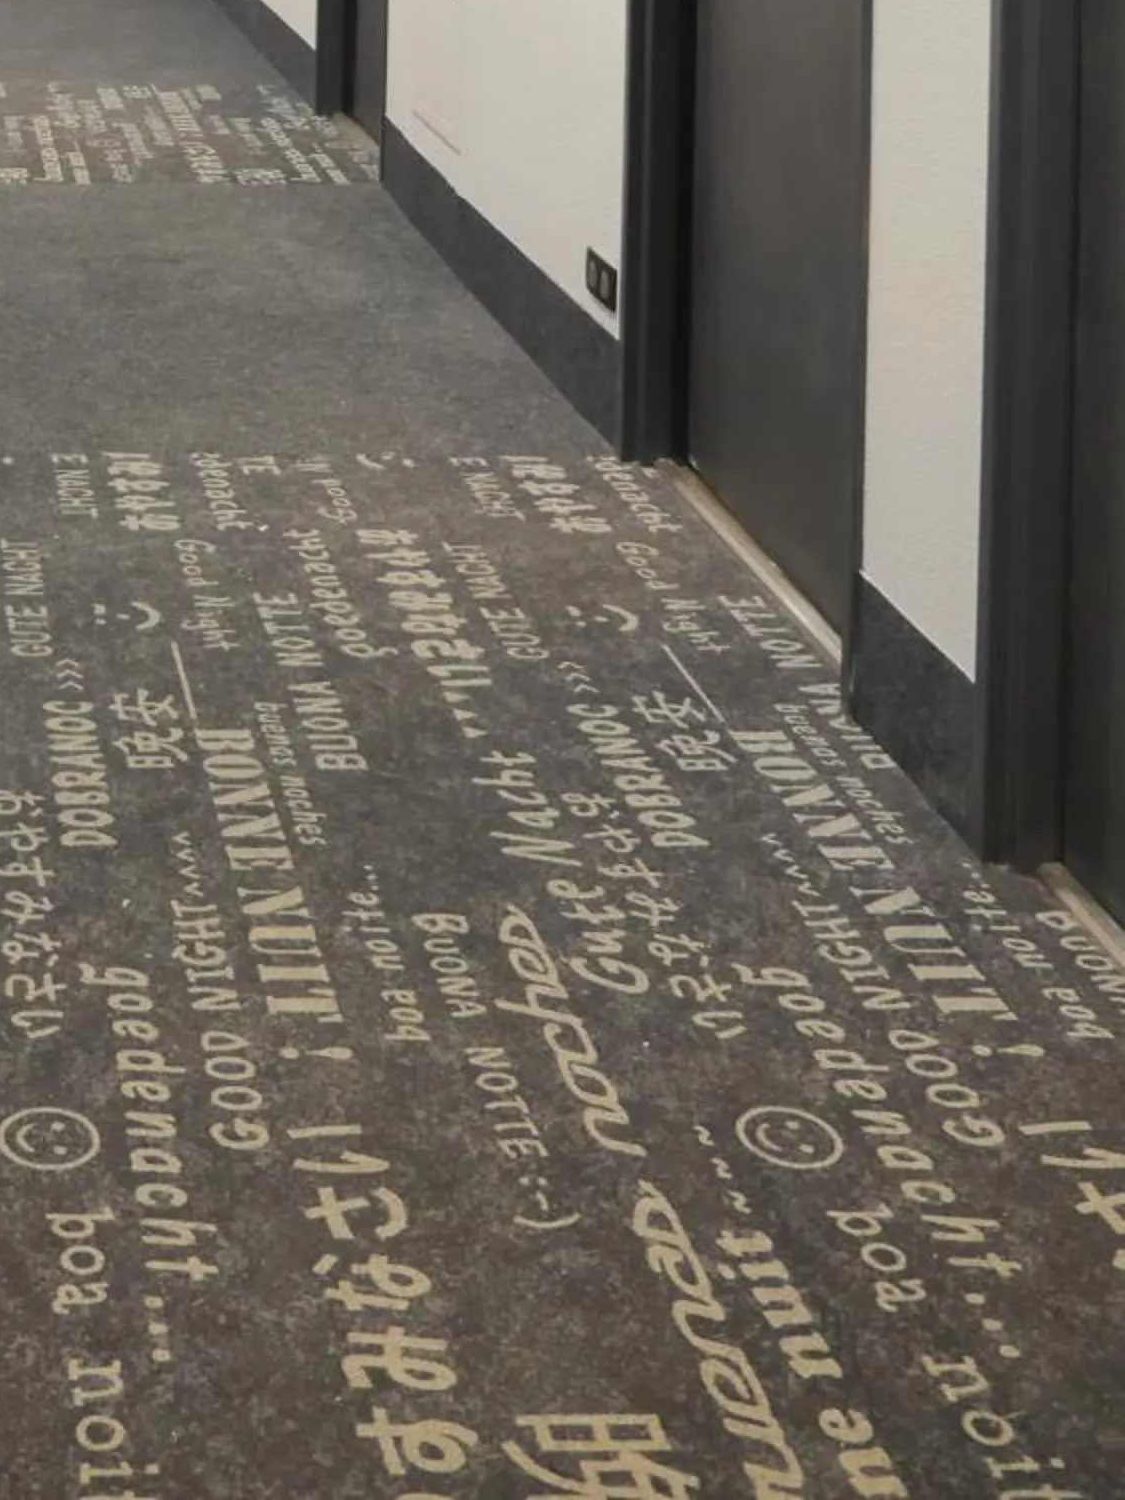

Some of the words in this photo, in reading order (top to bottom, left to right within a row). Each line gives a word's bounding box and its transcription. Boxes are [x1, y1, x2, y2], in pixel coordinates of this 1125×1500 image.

[0, 538, 43, 595] NACHT
[174, 539, 219, 586] Good
[283, 528, 399, 658] goedenacht
[442, 542, 505, 598] NACHT
[616, 541, 679, 590] Good
[4, 605, 53, 657] GUTE
[252, 592, 323, 666] NOTTE
[479, 607, 549, 659] GUTE
[717, 595, 822, 668] NOTTE
[43, 701, 116, 846] DOBRANOC
[254, 702, 297, 765] buenas
[280, 775, 327, 845] noches
[288, 681, 367, 769] BUONA
[567, 704, 709, 847] DOBRANOC
[774, 704, 846, 766] buenas
[835, 776, 914, 844] noches
[193, 728, 294, 870] BONNE
[472, 750, 583, 867] Nacht
[561, 793, 746, 1039] おやすみなさい
[728, 729, 895, 870] BONNE
[849, 886, 1018, 1020] NUIT
[237, 887, 343, 1023] NUIT
[547, 879, 650, 994] Gute
[381, 989, 431, 1041] boa
[411, 913, 510, 1017] BUONA
[464, 1047, 548, 1158] NOTTE
[453, 903, 646, 1156] noches
[1042, 988, 1114, 1040] boa
[201, 1030, 269, 1149] GOOD
[888, 1029, 1005, 1146] GOOD
[46, 1205, 116, 1315] boa
[286, 1125, 478, 1500] すみなさい
[716, 1230, 842, 1378] nuit
[826, 1203, 926, 1311] boa
